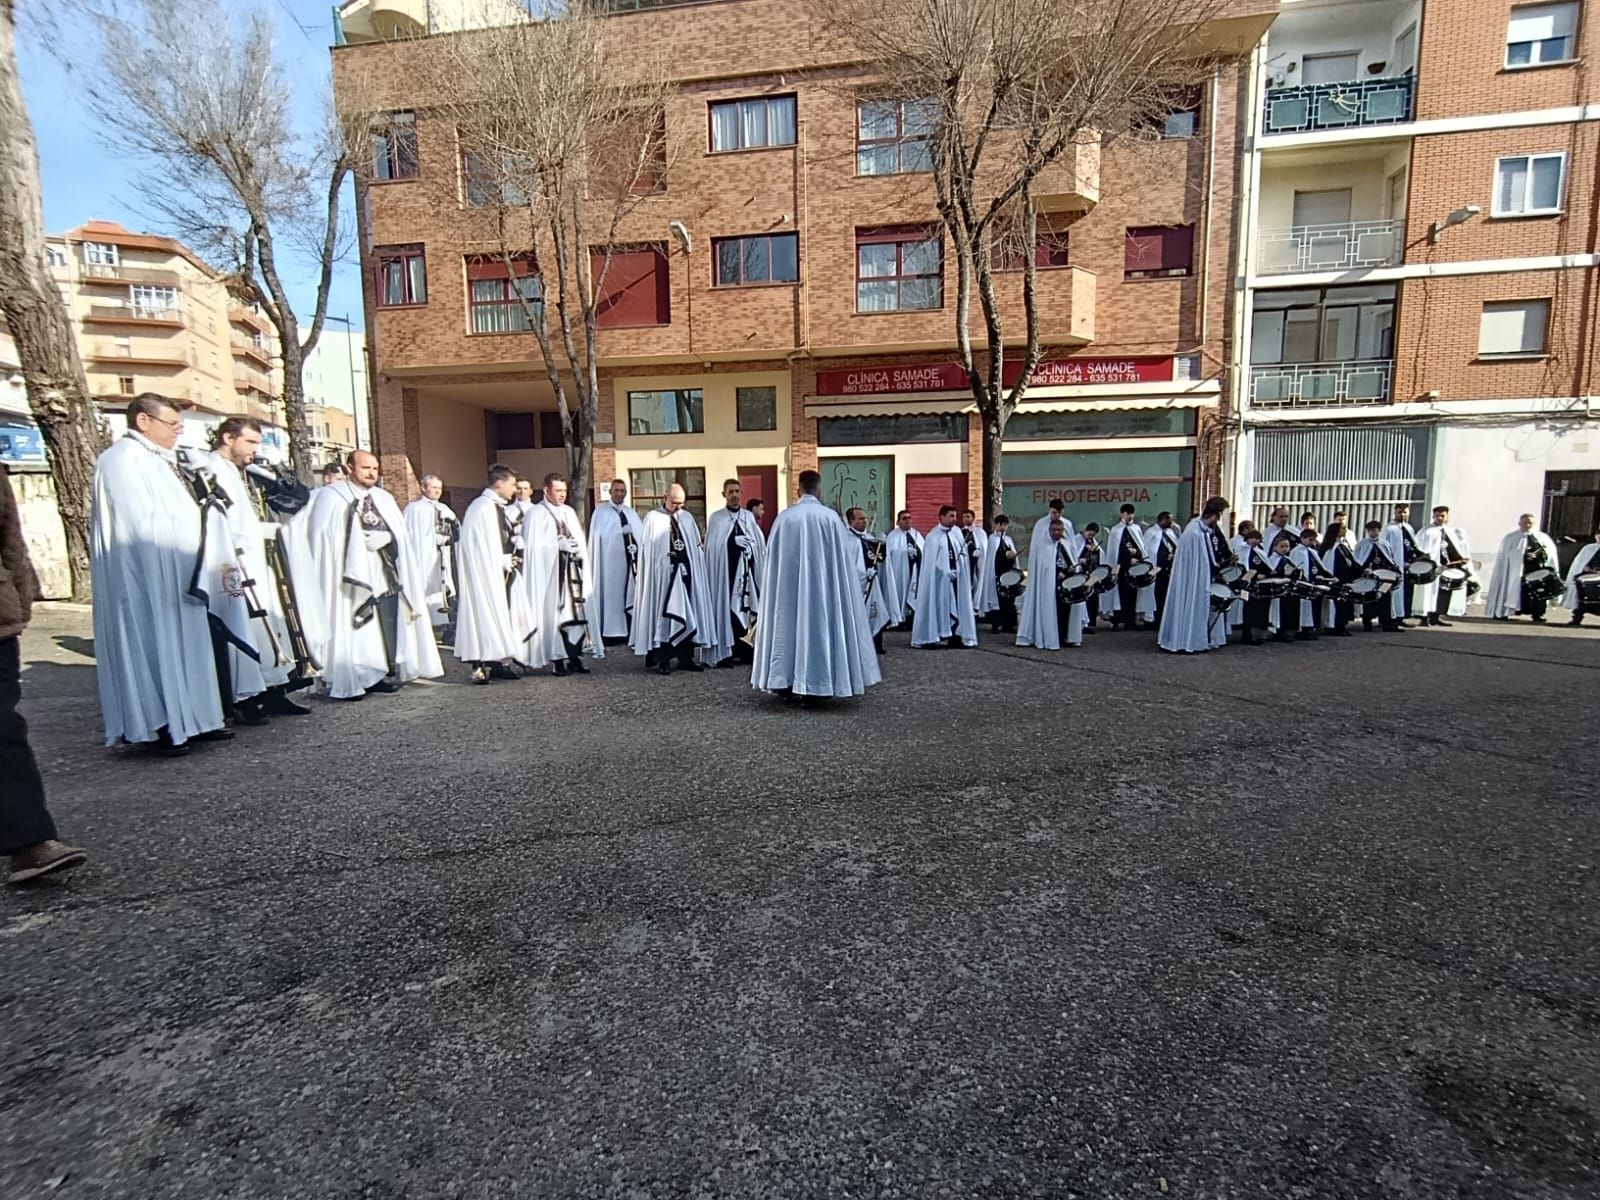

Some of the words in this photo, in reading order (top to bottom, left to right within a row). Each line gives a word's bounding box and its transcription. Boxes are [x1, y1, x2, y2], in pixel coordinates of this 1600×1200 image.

[1037, 362, 1081, 375] CLÍNICA
[1087, 361, 1135, 374] SAMADE
[847, 371, 889, 385] CLÍNICA
[893, 368, 939, 382] SAMADE
[1031, 375, 1047, 384] 980
[1049, 374, 1065, 383] 522
[1066, 373, 1082, 382] 284
[1090, 373, 1105, 382] 635
[1108, 373, 1123, 382] 531
[1125, 373, 1140, 381] 781
[843, 384, 857, 393] 980
[858, 383, 873, 392] 522
[875, 382, 890, 391] 284
[896, 381, 911, 390] 635
[913, 380, 928, 389] 531
[930, 379, 945, 388] 781
[1032, 487, 1151, 504] FISIOTERAPIA
